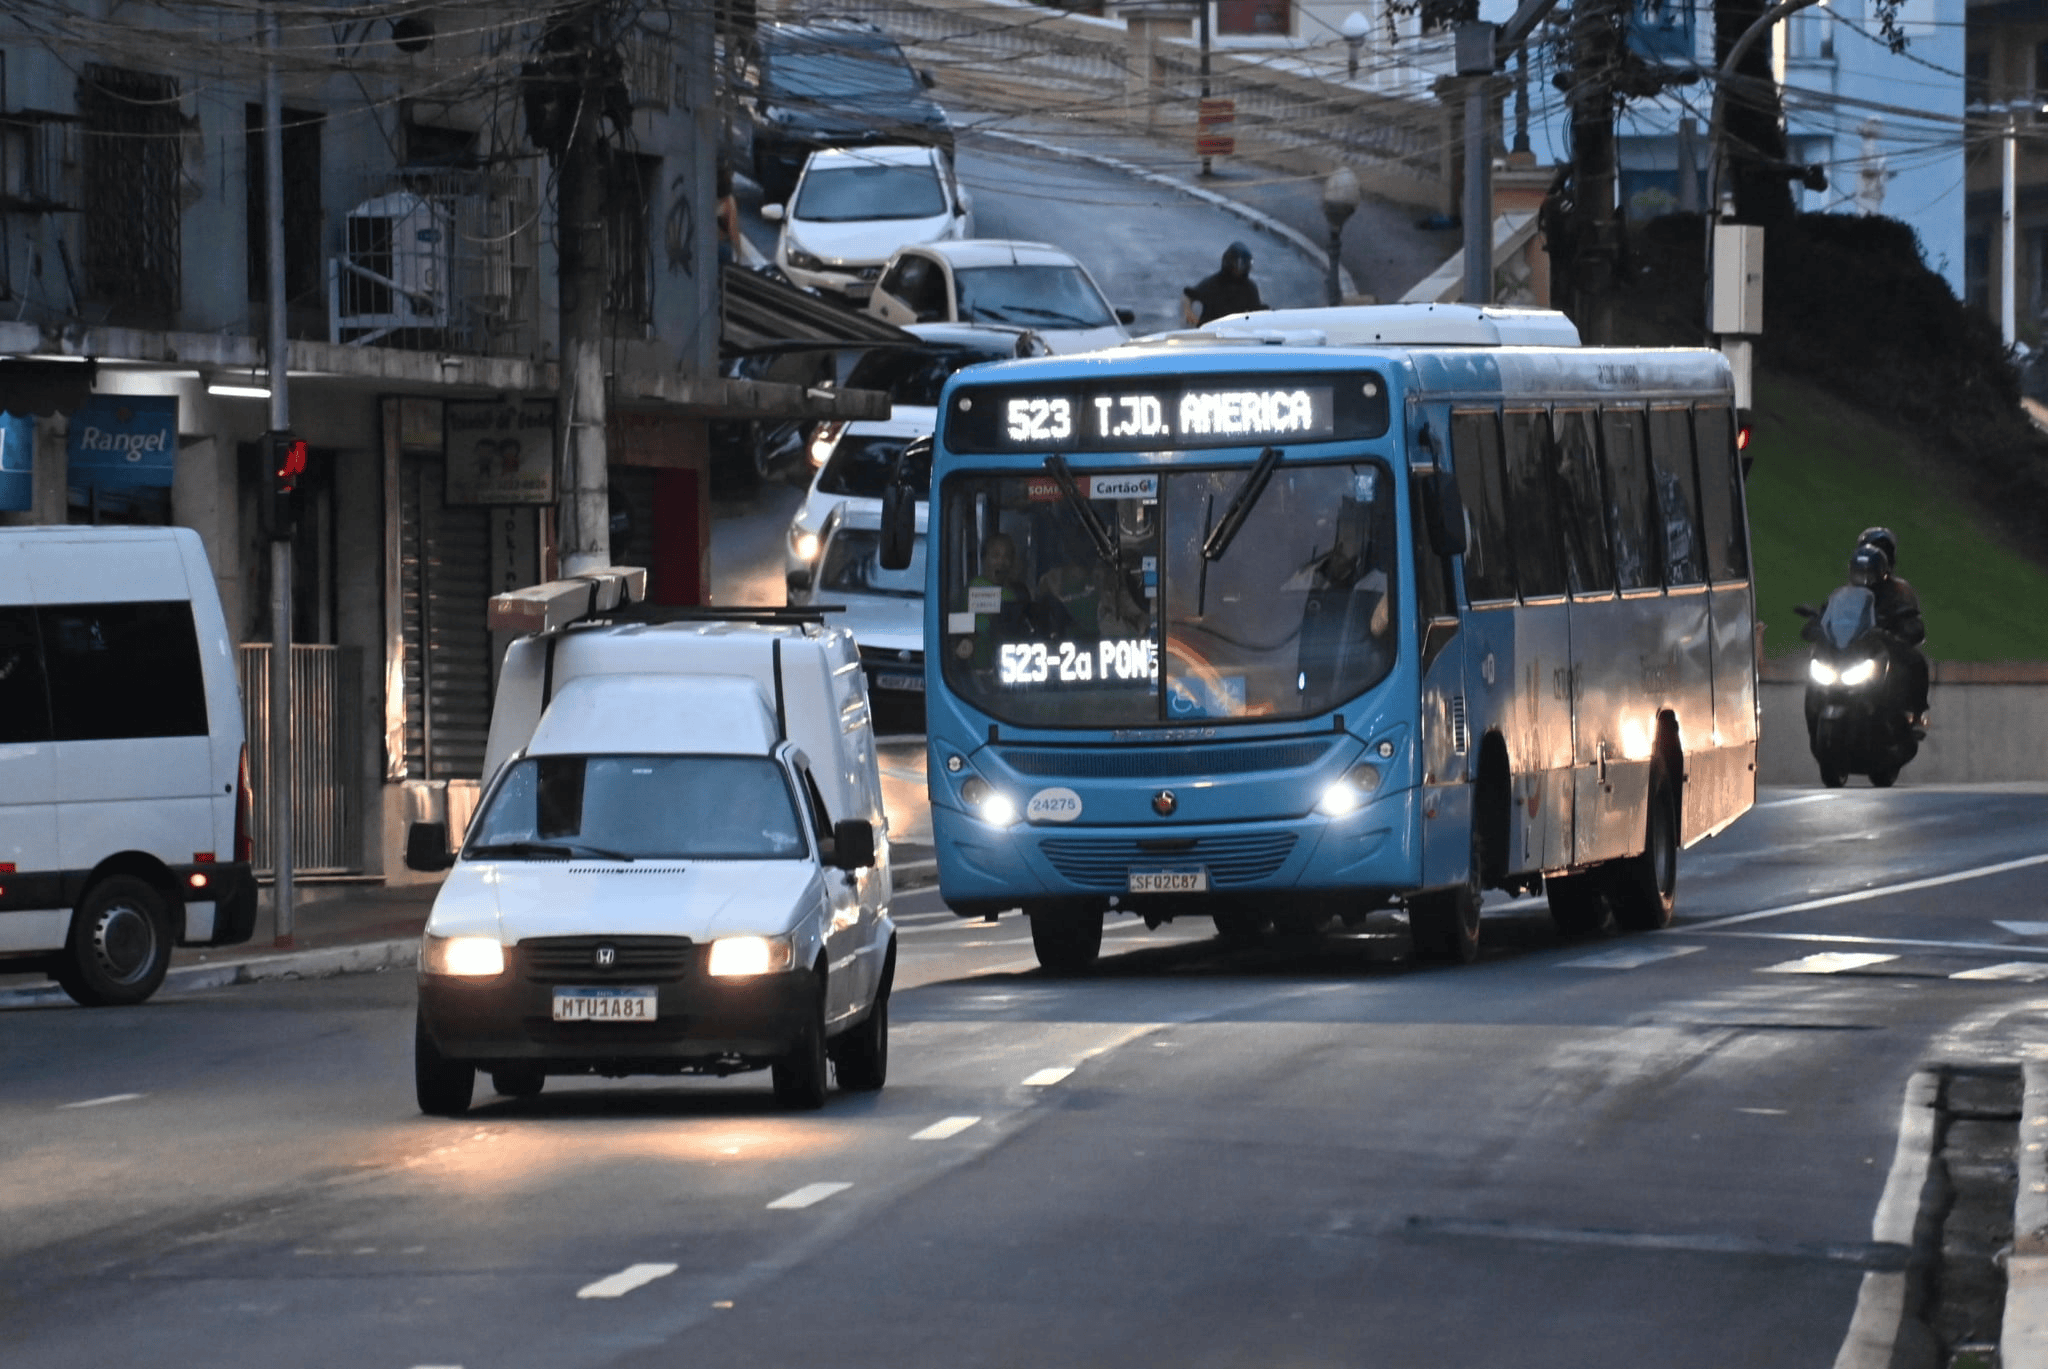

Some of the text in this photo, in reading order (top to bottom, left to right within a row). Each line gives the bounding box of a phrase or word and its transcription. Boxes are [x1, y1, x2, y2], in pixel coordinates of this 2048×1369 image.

[1007, 391, 1312, 440] 523 T.JD. AMERICA
[81, 427, 166, 462] Rangel
[1033, 798, 1076, 811] 24275
[562, 998, 645, 1018] MTU1A81
